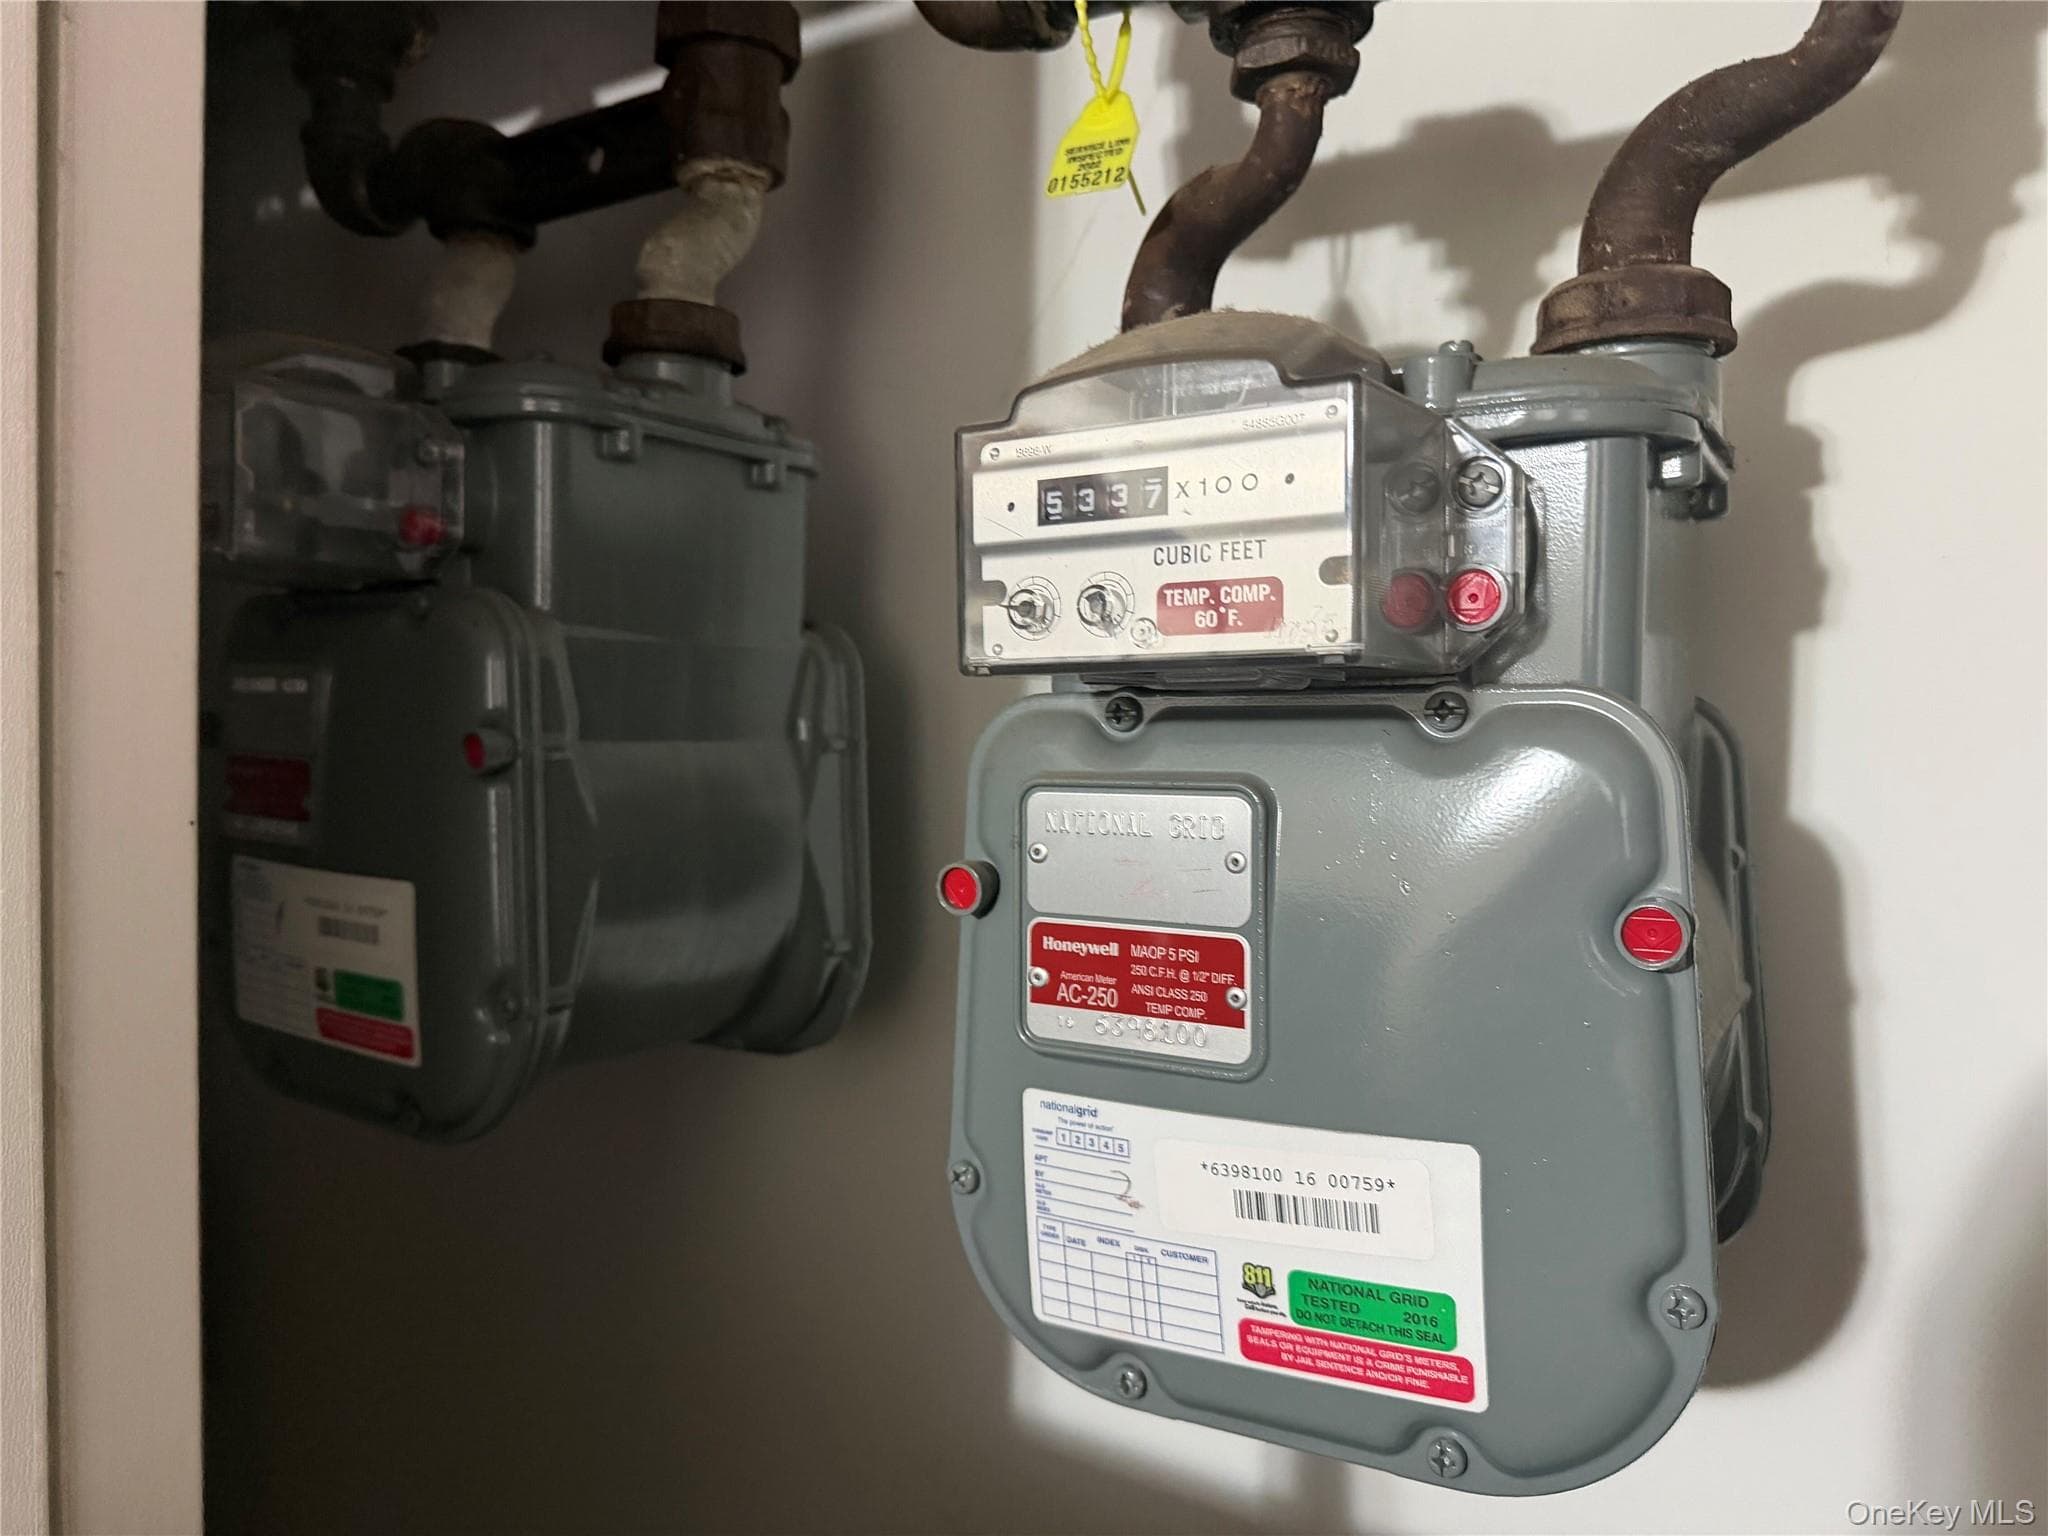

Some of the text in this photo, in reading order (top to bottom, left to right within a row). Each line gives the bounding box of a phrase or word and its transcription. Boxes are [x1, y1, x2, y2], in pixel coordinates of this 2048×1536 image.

[1048, 167, 1125, 193] 0155212
[1153, 540, 1268, 566] CUBIC FEET
[1164, 584, 1276, 607] TEMP. COMP.
[1045, 810, 1152, 838] NATIONAL
[1043, 936, 1120, 958] Honeywell
[1130, 944, 1200, 963] MAOP 5 PSI
[1060, 971, 1118, 986] American Meter
[1130, 965, 1147, 977] 250
[1057, 985, 1119, 1008] AC-250
[1131, 985, 1208, 1003] ANSI CLASS 250
[1146, 1002, 1173, 1016] TEMP
[1040, 1099, 1098, 1118] nationalgrid
[1070, 1119, 1086, 1128] power
[1295, 1171, 1317, 1186] 16
[1066, 1236, 1086, 1247] DATE
[1096, 1236, 1121, 1248] INDEX
[1160, 1248, 1209, 1264] CUSTOMER
[1243, 1262, 1273, 1288] 811
[1308, 1278, 1430, 1308] NATIONAL GRID
[1301, 1294, 1360, 1314] TESTED
[1403, 1312, 1439, 1327] 2016
[1296, 1308, 1311, 1320] DO
[1313, 1311, 1339, 1326] NOT
[1340, 1315, 1386, 1334] DETACH
[1386, 1324, 1414, 1339] THIS
[1416, 1328, 1446, 1345] SEAL
[1249, 1324, 1304, 1343] TAMPERING
[1304, 1333, 1329, 1346] WITH
[1330, 1337, 1377, 1357] NATIONAL
[1247, 1335, 1469, 1385] SEALS OR EQUIPMENT IS A CRIME PUNISHABLE
[1281, 1352, 1431, 1390] BY JAIL SENTENCE AND/OR FINE.
